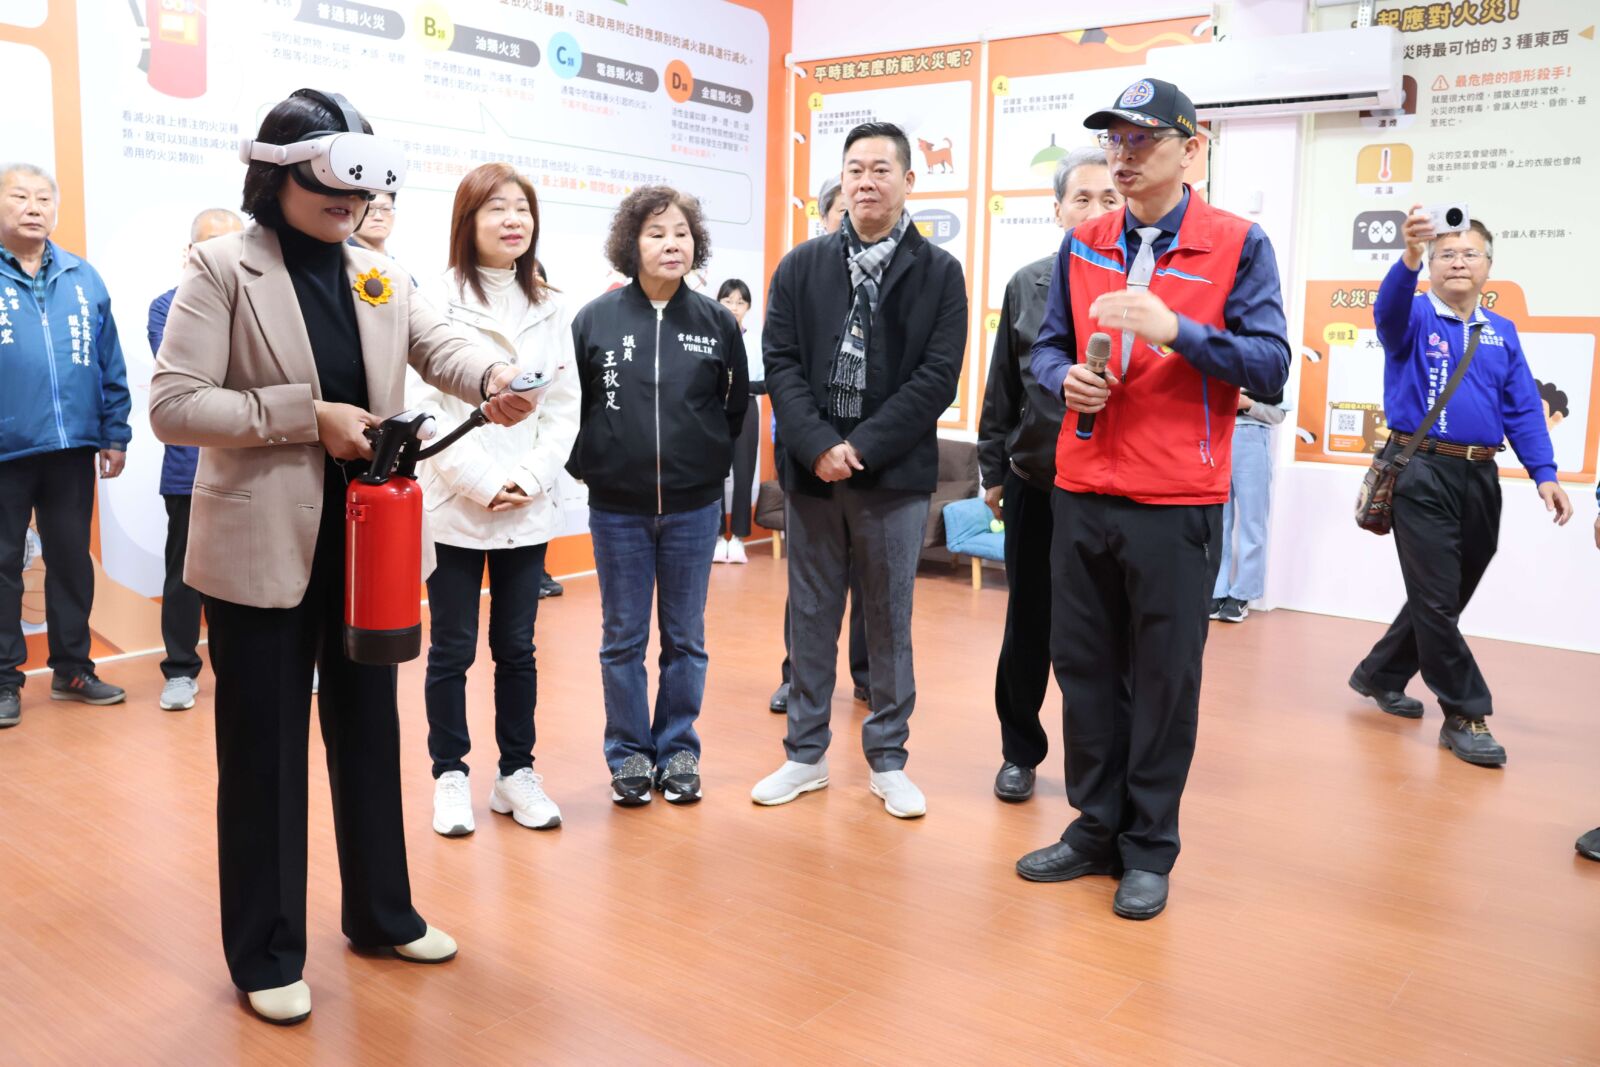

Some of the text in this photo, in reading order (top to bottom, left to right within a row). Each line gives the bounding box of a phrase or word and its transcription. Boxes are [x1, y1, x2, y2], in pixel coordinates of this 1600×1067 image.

[317, 2, 385, 31] 普通類火災
[1351, 0, 1520, 33] 起應對火災!
[475, 35, 521, 59] 油類火災
[1516, 29, 1569, 50] 種東西
[596, 62, 645, 85] 電器類火災
[814, 50, 973, 83] 平時該怎麼防範火災呢？
[700, 86, 742, 107] 金屬類火災
[997, 82, 1007, 91] 4.
[994, 201, 1003, 211] 5.
[622, 334, 636, 362] 議員
[683, 343, 713, 355] YUNLIN
[602, 351, 621, 411] 王秋足
